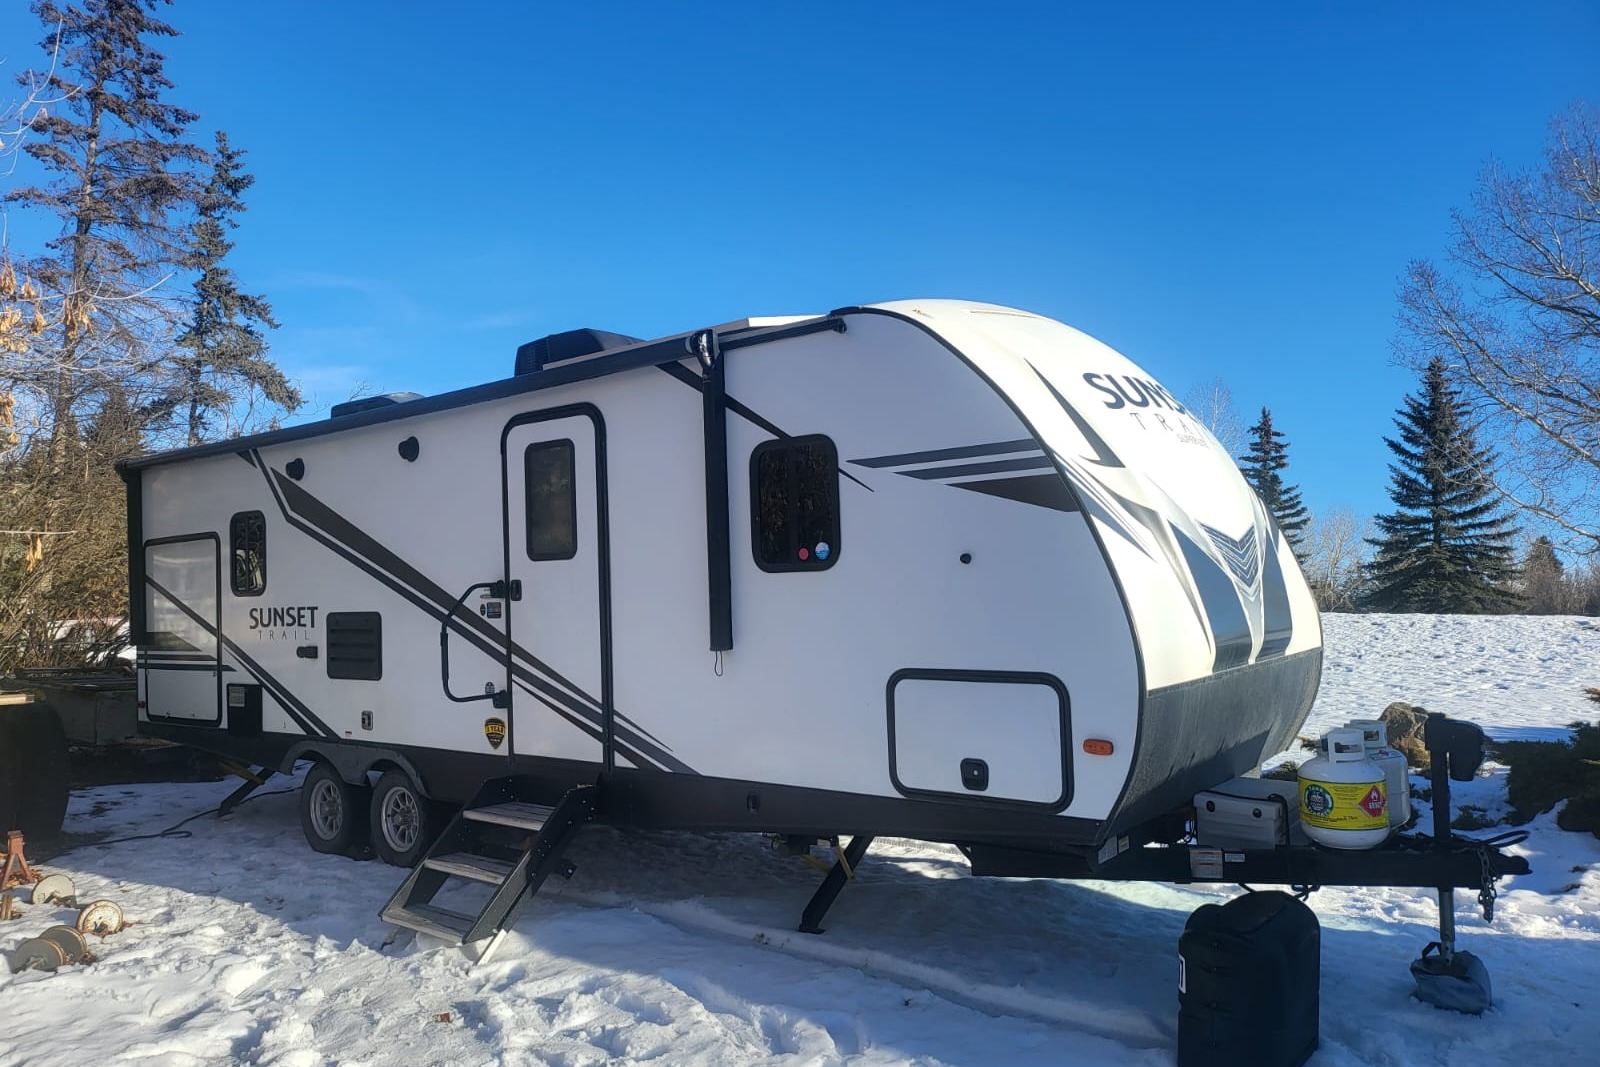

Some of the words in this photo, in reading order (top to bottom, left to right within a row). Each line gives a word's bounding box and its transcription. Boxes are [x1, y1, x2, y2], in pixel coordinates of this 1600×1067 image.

[1082, 372, 1188, 415] SUNS
[249, 606, 318, 629] SUNSET
[258, 629, 309, 640] TRAIL
